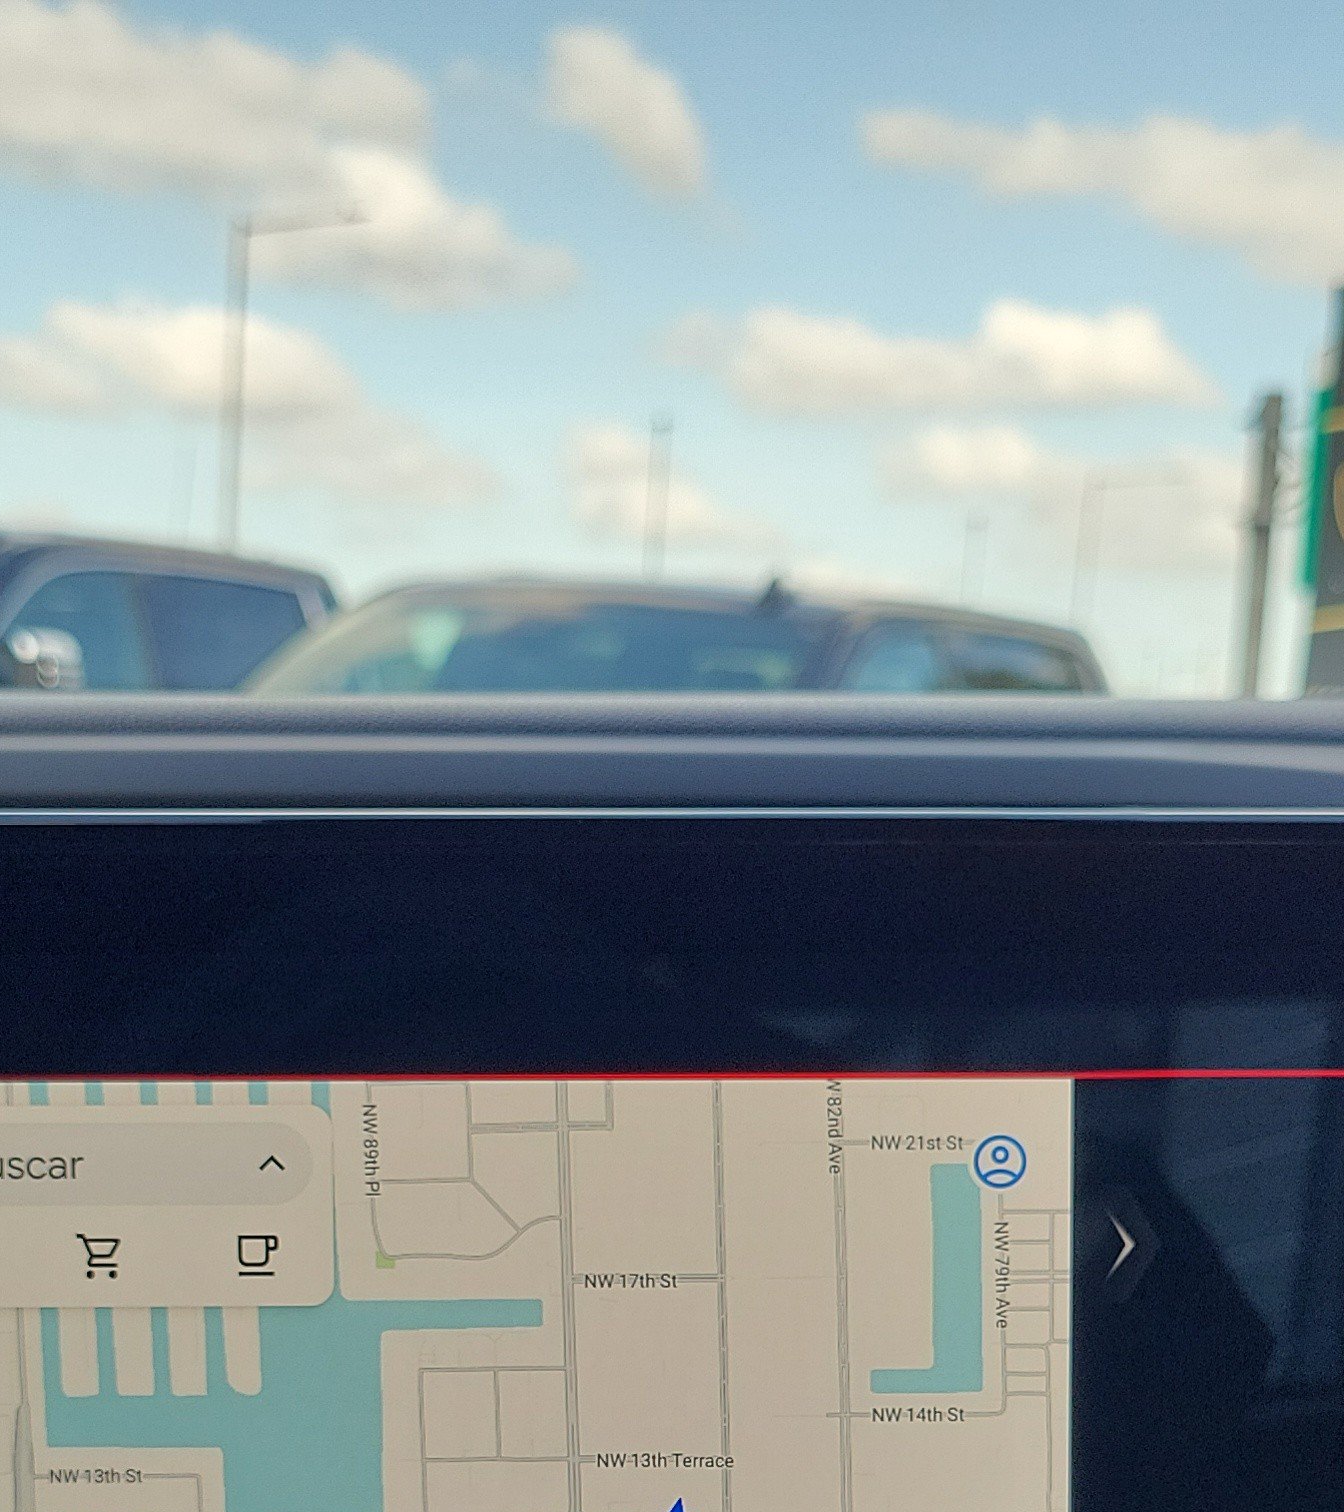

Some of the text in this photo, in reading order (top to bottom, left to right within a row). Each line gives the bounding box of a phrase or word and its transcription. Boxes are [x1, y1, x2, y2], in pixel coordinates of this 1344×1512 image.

[826, 1097, 843, 1138] 82nd
[362, 1104, 381, 1196] NW 89th Pl
[871, 1135, 964, 1150] NW 21st St
[828, 1142, 843, 1174] Ave
[584, 1273, 678, 1289] NW 17th St
[994, 1222, 1010, 1328] NW 79th Ave
[871, 1407, 965, 1422] NW 14th St
[596, 1453, 734, 1468] NW 13th Terrace
[50, 1469, 143, 1483] NW 13th St
